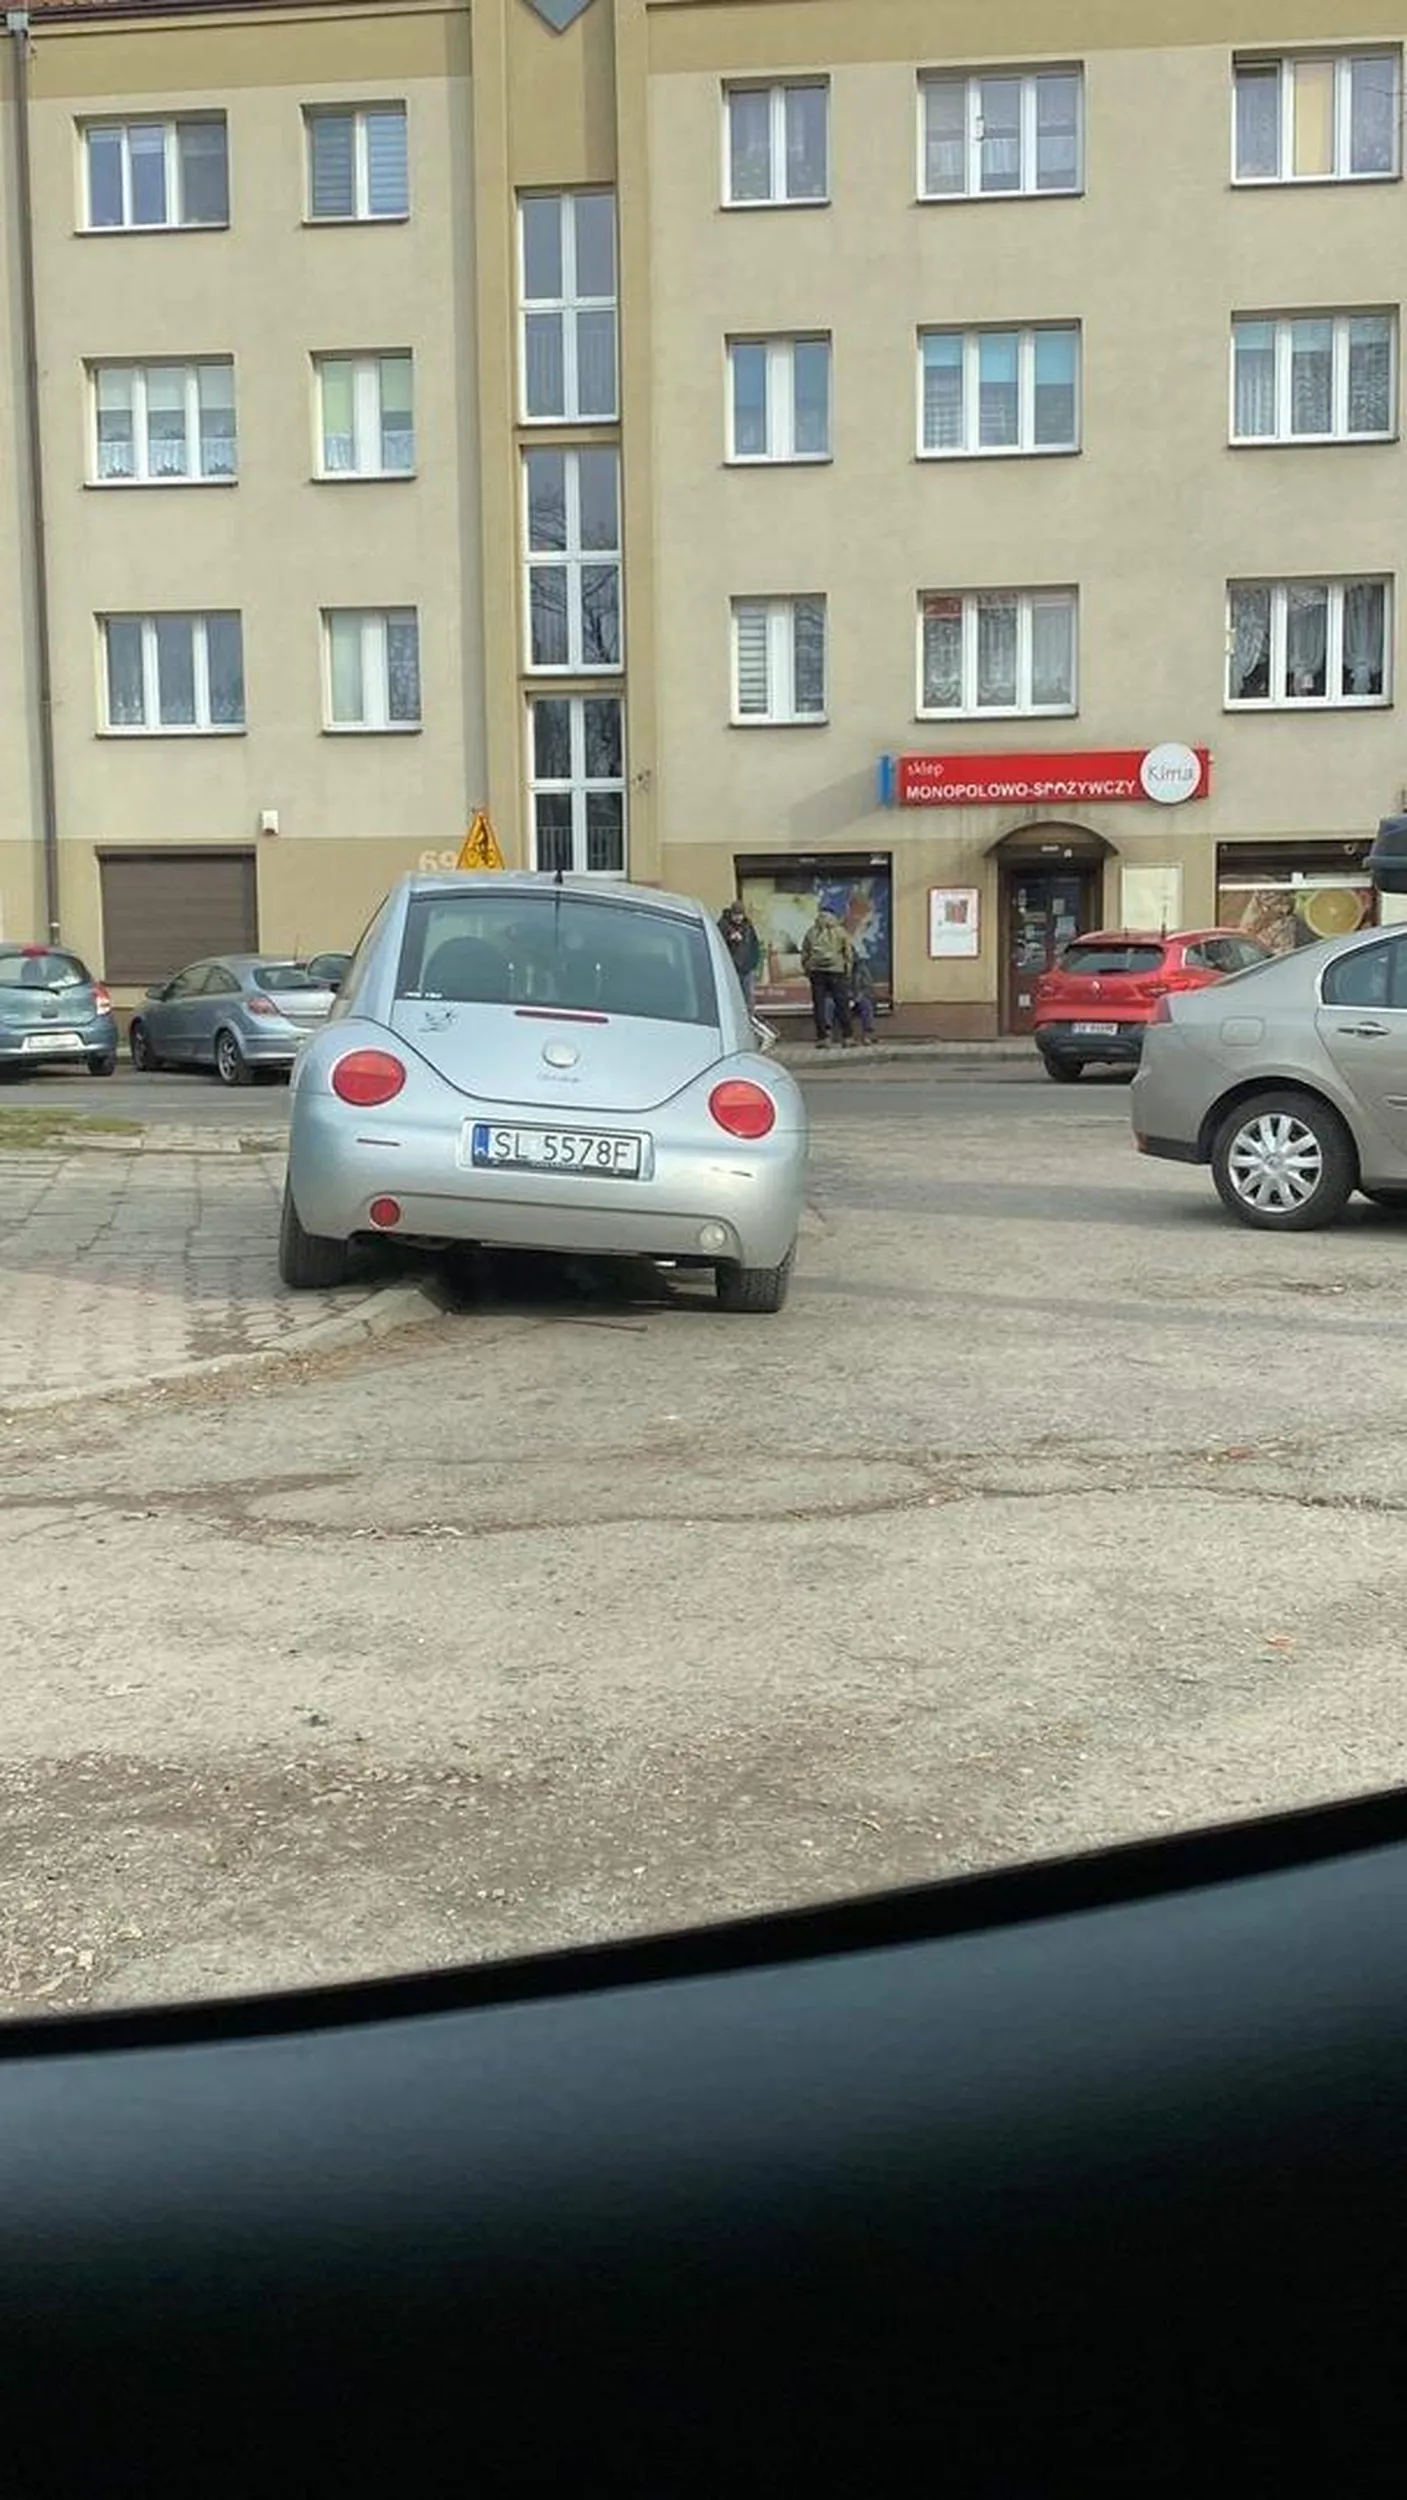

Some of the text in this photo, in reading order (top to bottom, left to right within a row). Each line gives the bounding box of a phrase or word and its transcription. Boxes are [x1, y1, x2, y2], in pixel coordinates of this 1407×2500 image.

[907, 761, 944, 778] sklep
[494, 1131, 630, 1168] SL 5578F
